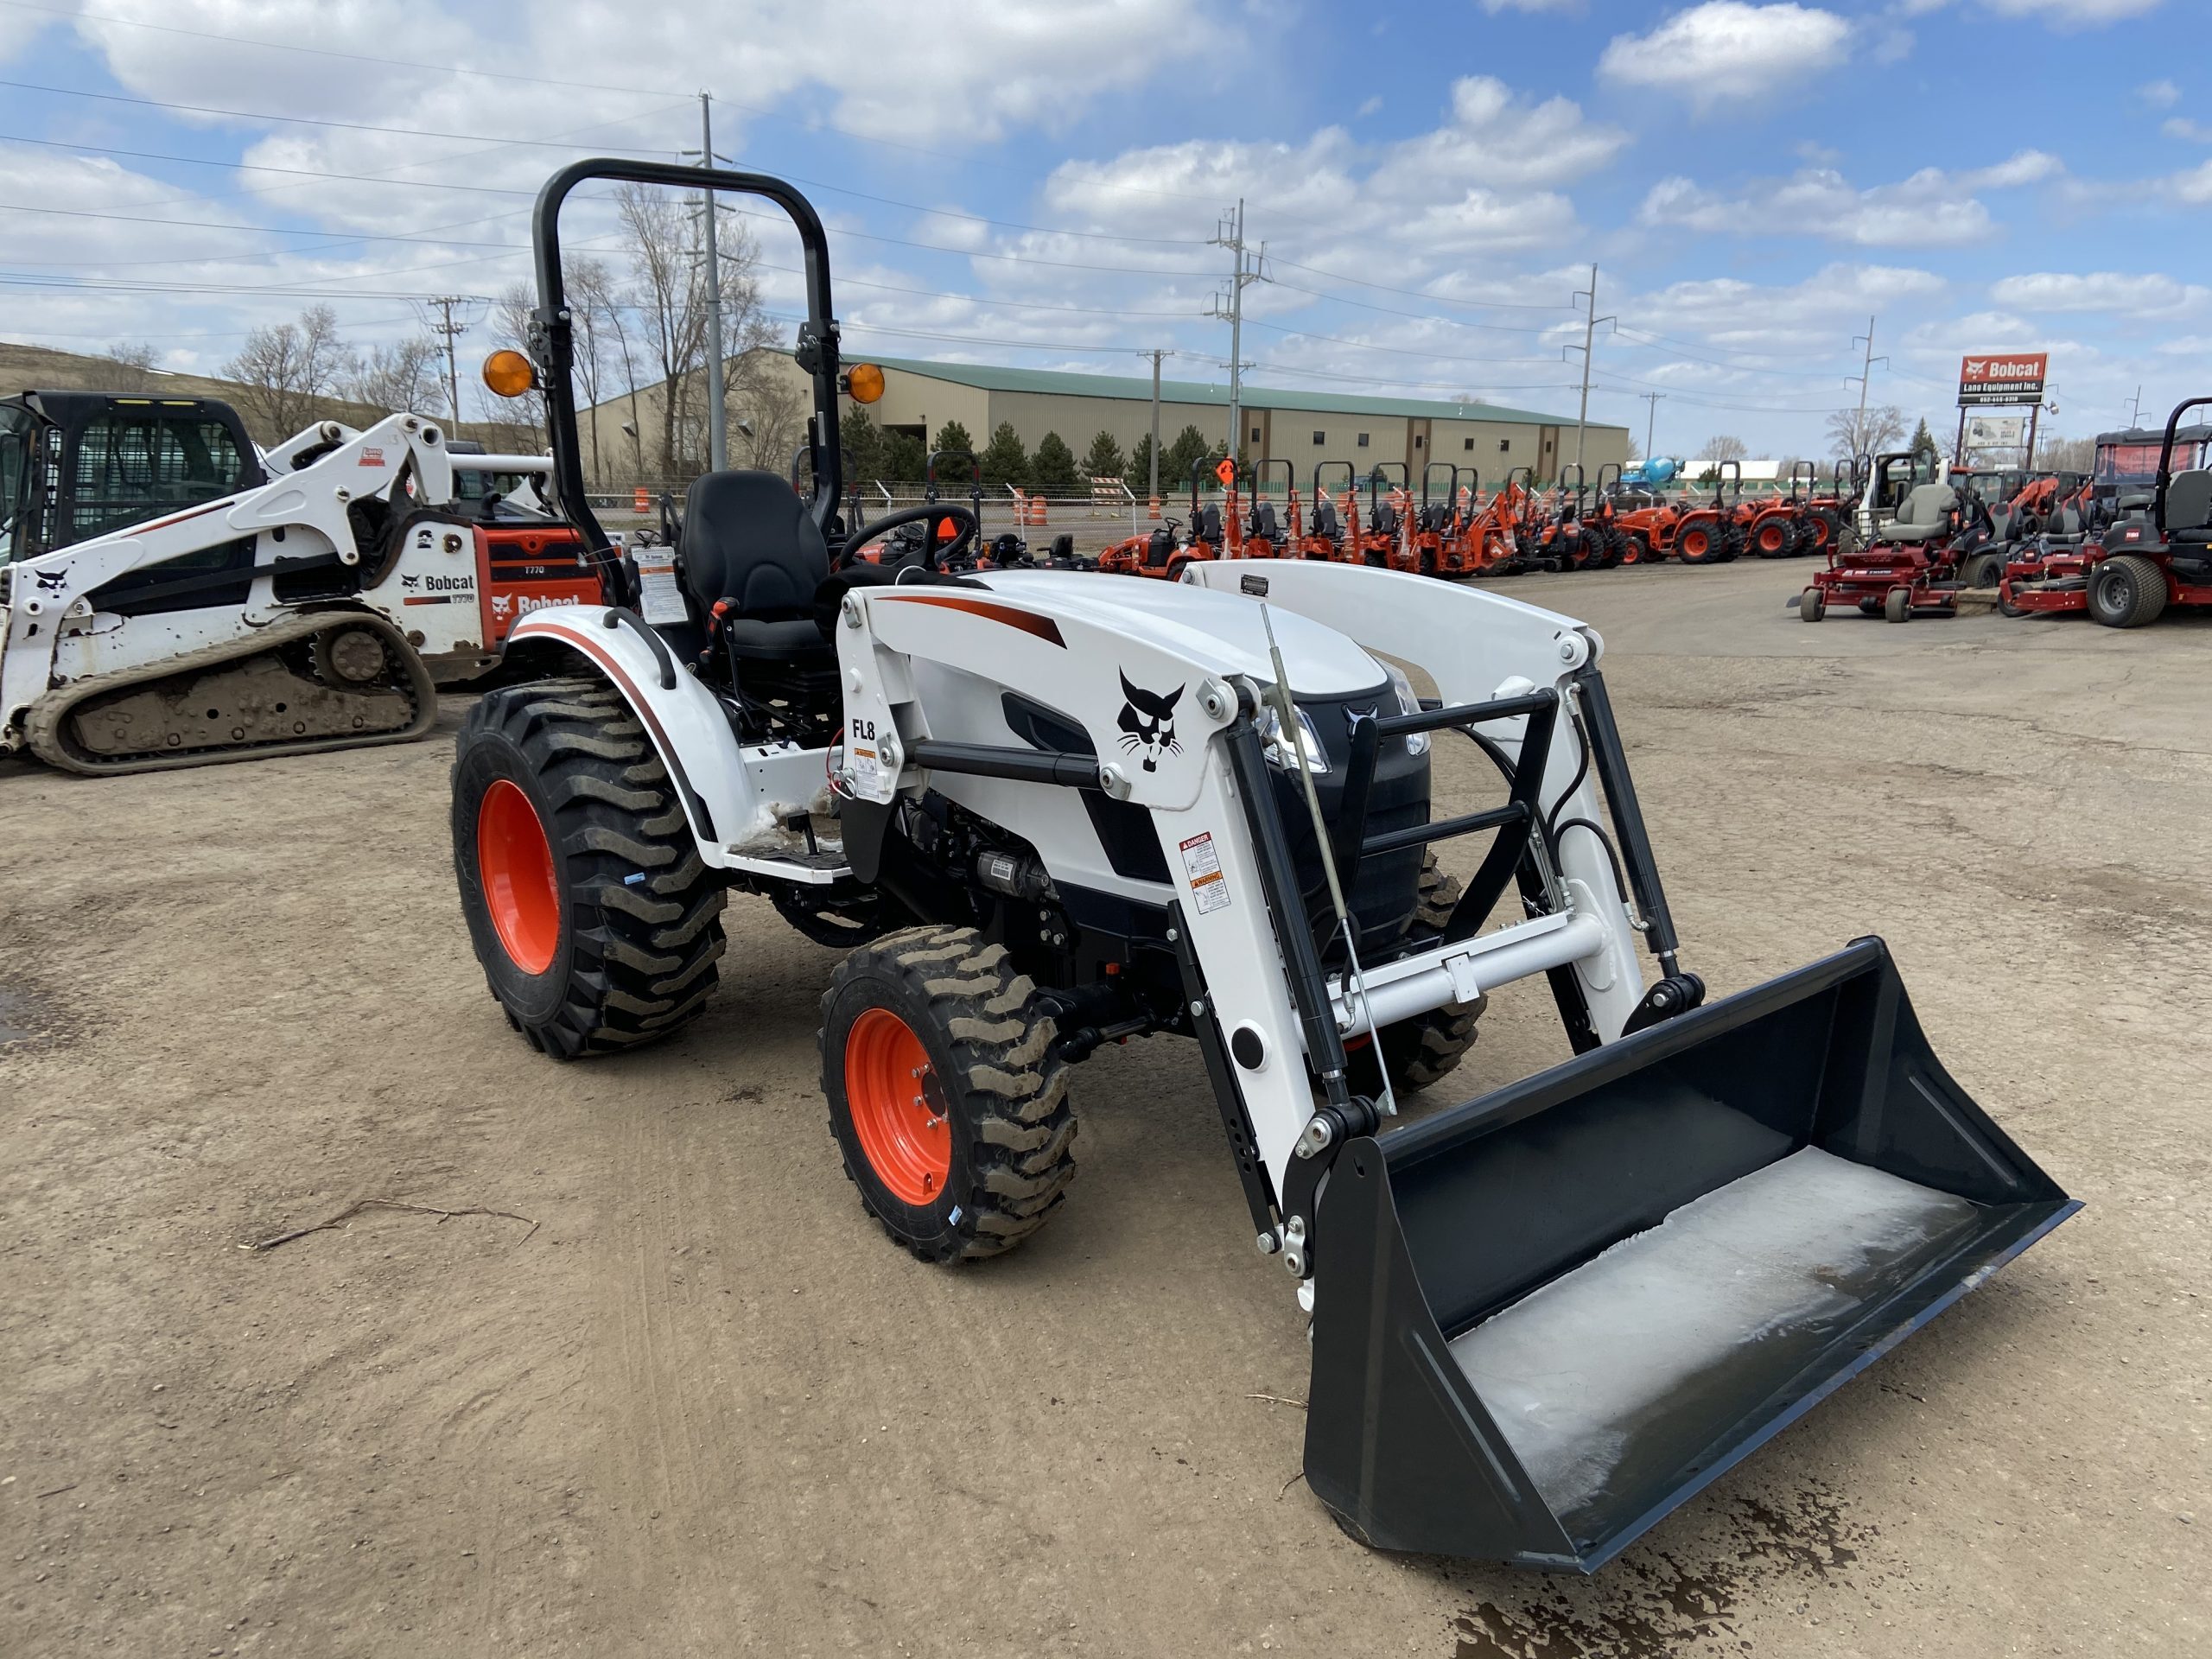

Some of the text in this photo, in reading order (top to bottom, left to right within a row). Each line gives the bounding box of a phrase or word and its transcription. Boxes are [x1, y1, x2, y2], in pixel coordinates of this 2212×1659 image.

[1989, 361, 2039, 378] Bobcat
[1963, 382, 2038, 392] Lano Equipment Inc.
[524, 566, 544, 575] T770
[425, 574, 474, 591] Bobcat
[452, 594, 474, 604] T770
[852, 718, 875, 741] FL8
[1187, 834, 1209, 847] DANGER
[1197, 873, 1220, 885] WARNING
